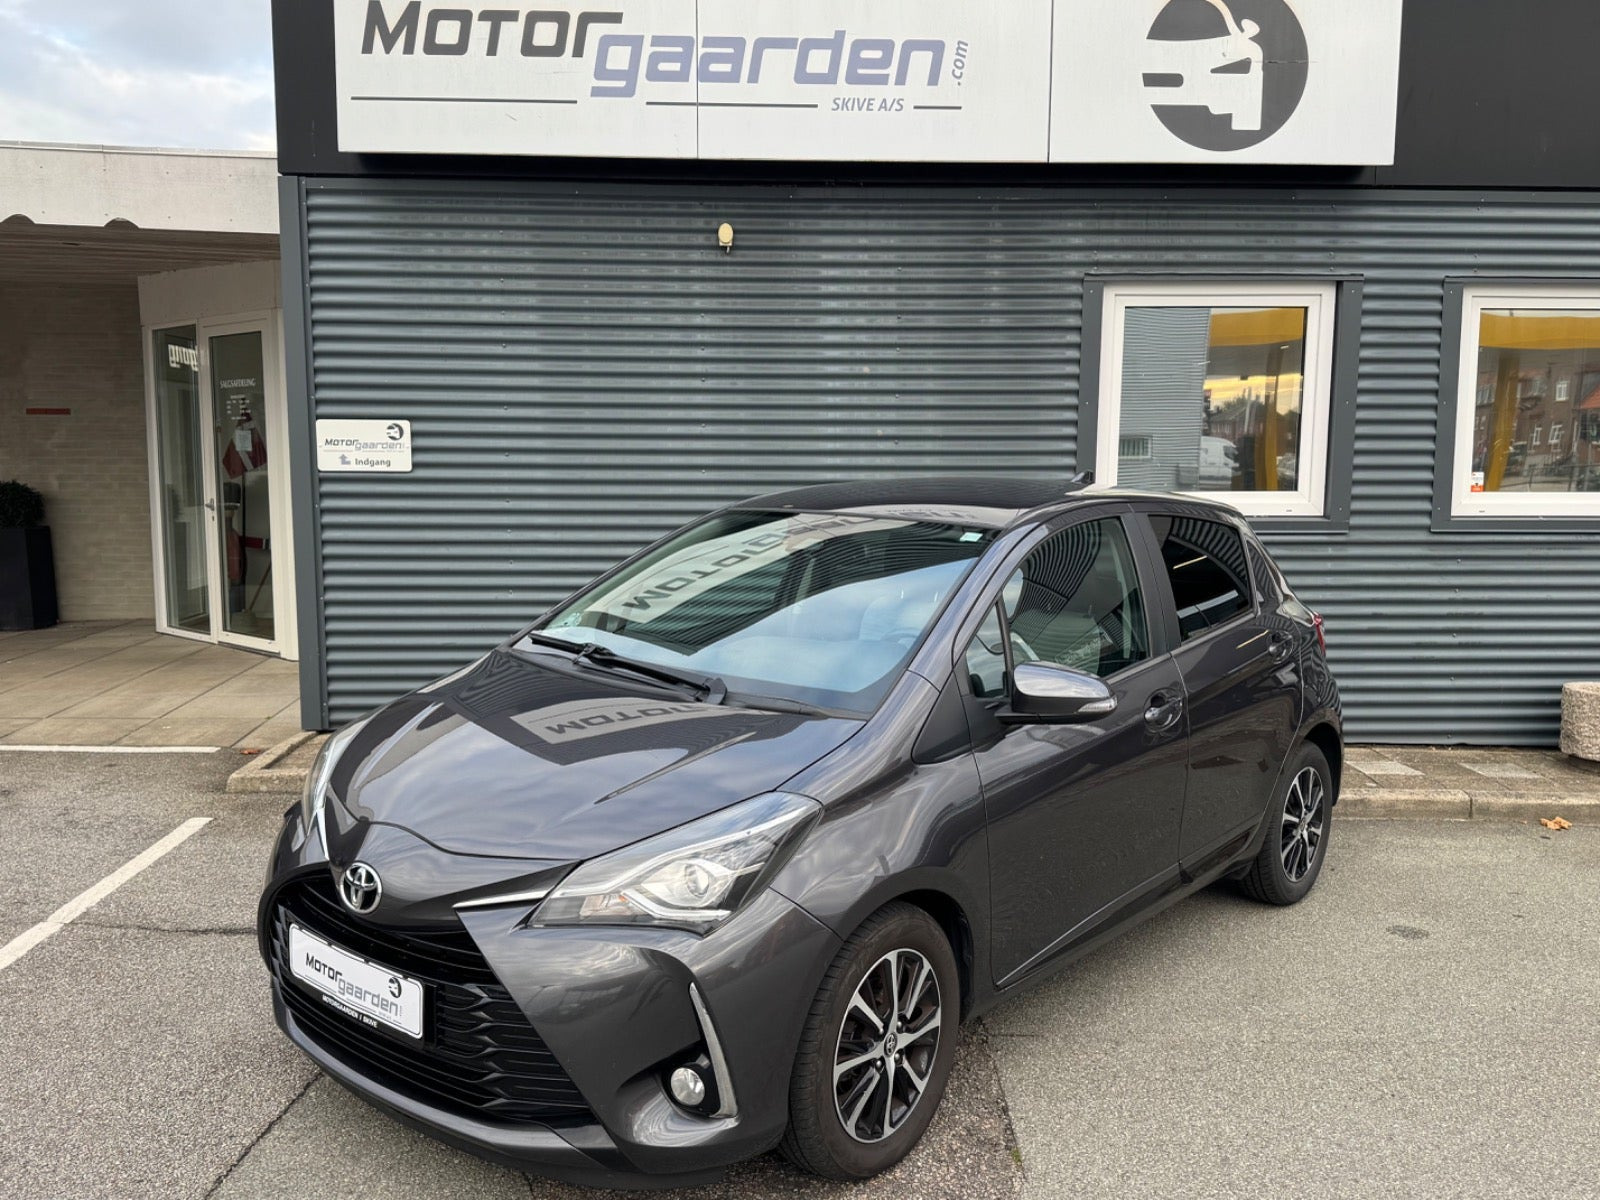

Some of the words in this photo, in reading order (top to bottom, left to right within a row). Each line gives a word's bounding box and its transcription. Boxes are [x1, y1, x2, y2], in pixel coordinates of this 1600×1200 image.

[590, 30, 946, 98] gaarden
[831, 97, 875, 112] SKIVE
[877, 98, 905, 112] A/S
[355, 458, 391, 467] Indgang
[338, 979, 399, 1017] gaarden
